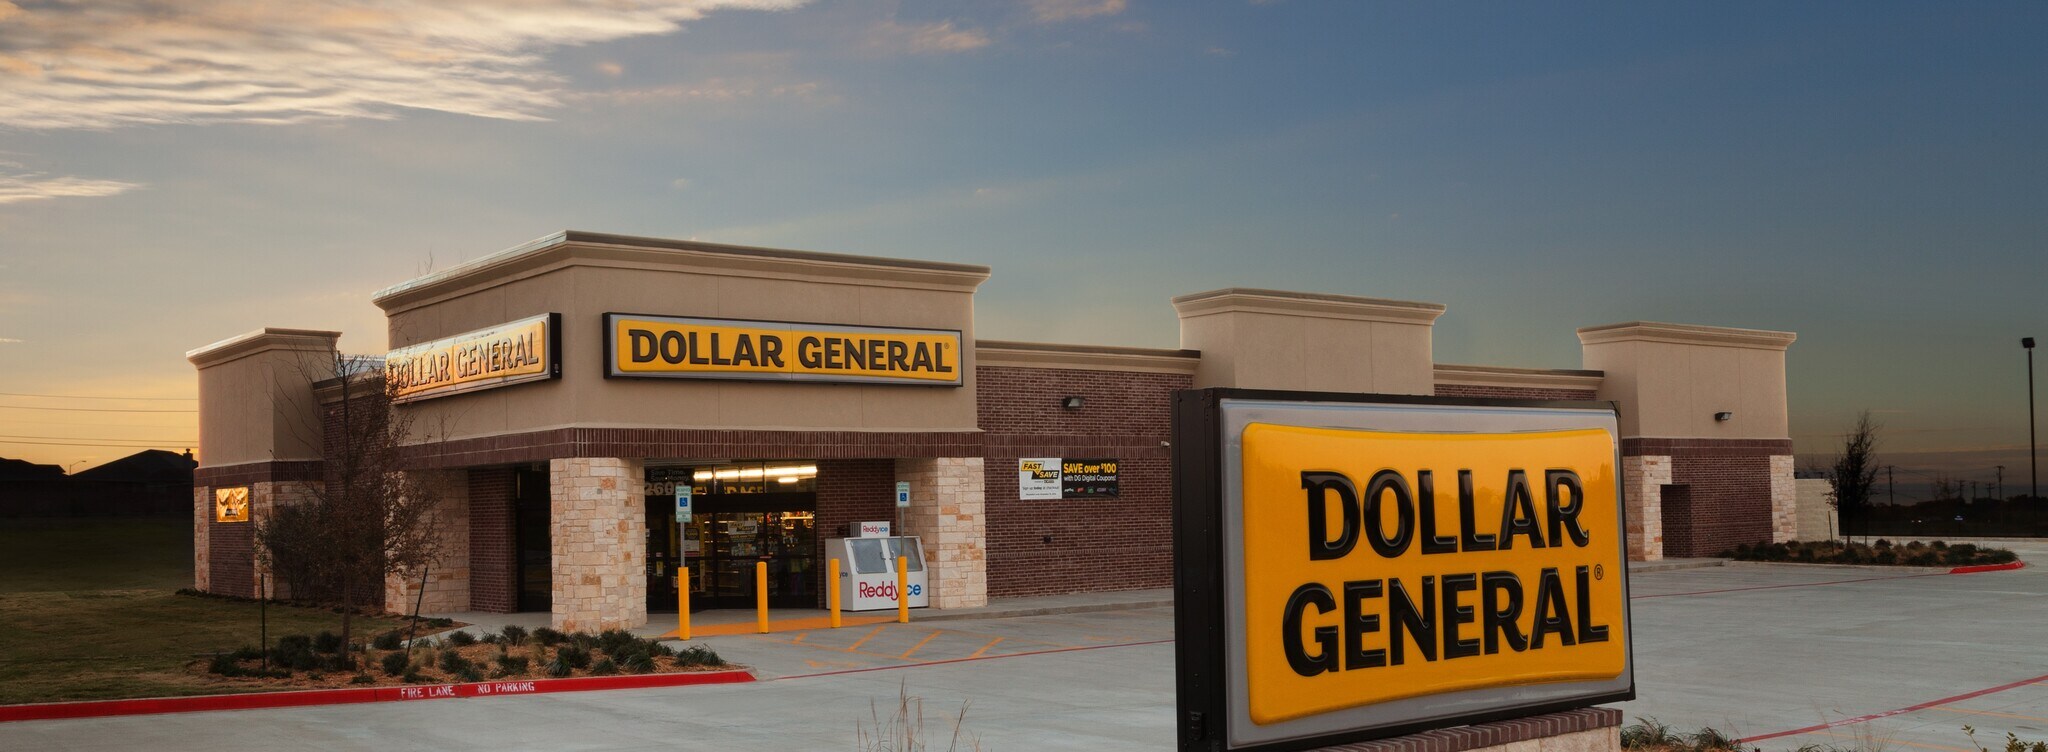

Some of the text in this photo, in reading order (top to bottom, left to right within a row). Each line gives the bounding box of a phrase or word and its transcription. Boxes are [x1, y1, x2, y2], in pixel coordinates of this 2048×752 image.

[628, 329, 784, 368] DOLLAR
[391, 332, 539, 390] DOLLAR GENERAL
[1064, 463, 1117, 474] SAVE over $100
[1082, 474, 1096, 482] Digital
[645, 481, 686, 496] 260
[1300, 468, 1590, 561] DOLLAR
[401, 682, 535, 698] FIRE LANE NO PARKING
